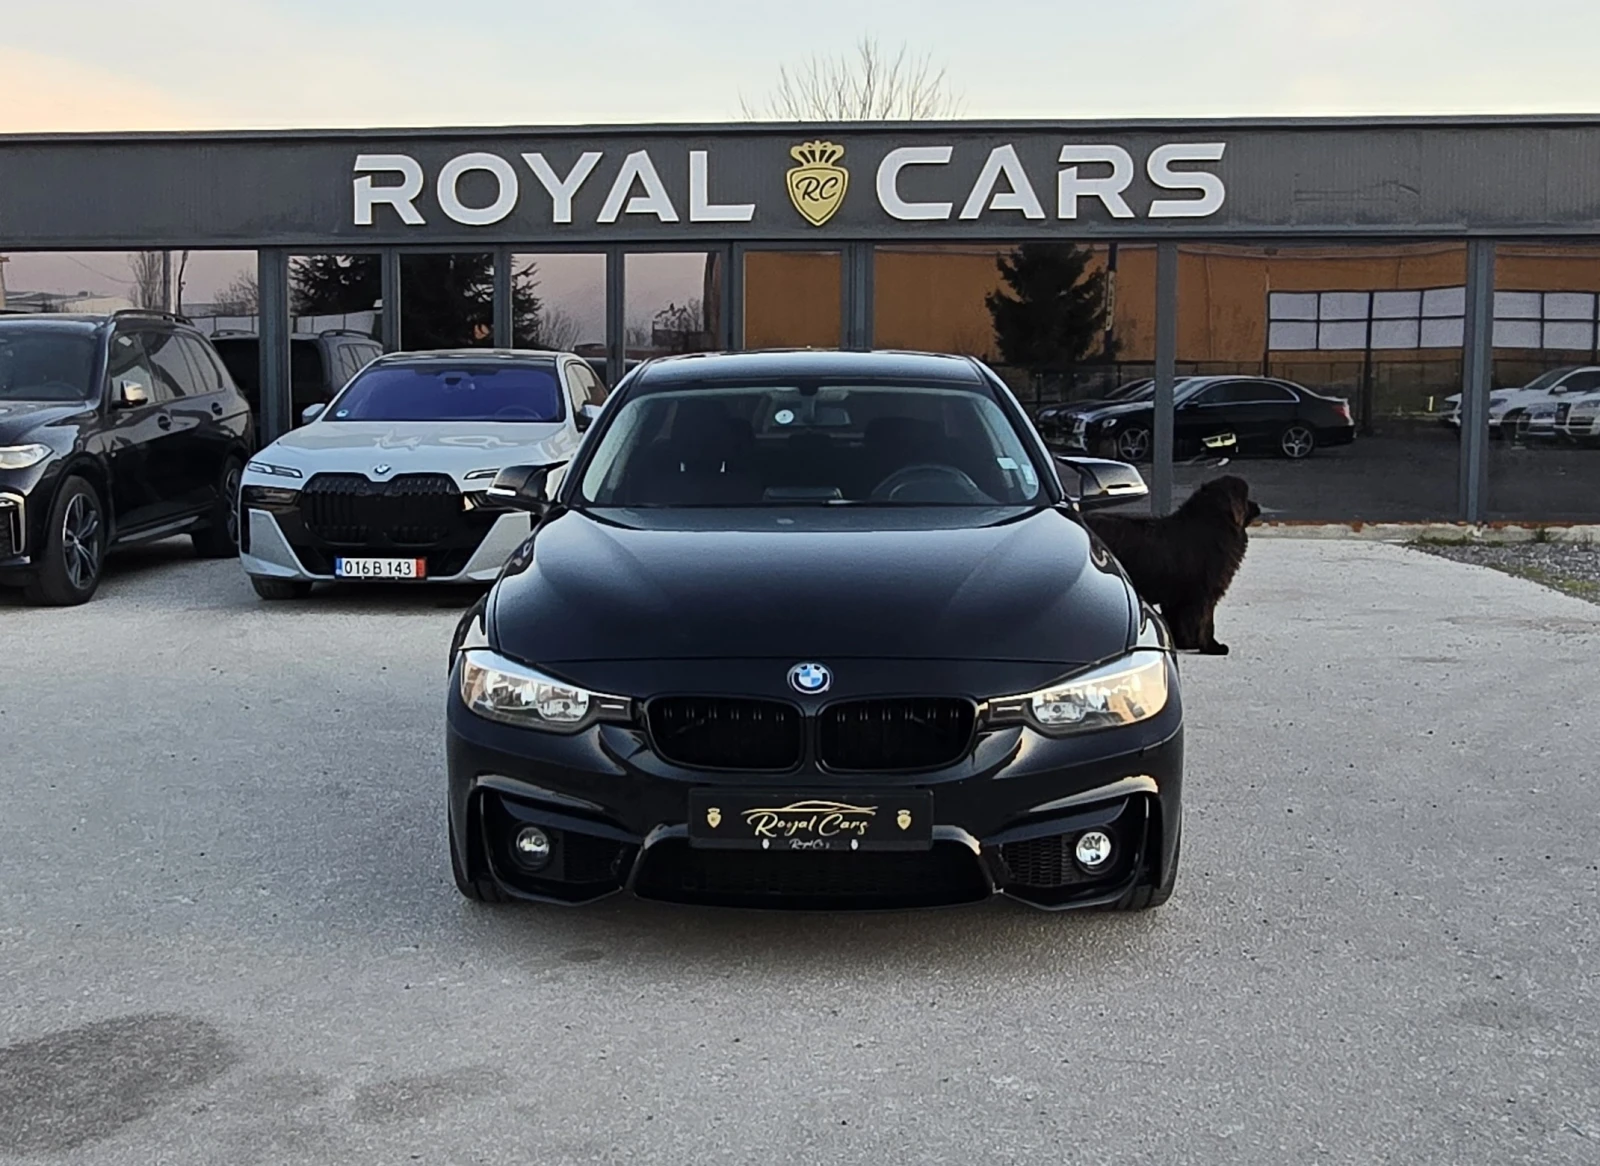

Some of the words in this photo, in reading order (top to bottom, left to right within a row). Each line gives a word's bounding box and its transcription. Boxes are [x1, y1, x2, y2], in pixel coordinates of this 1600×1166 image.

[353, 149, 756, 226] ROYAL
[876, 142, 1226, 220] CARS
[795, 176, 839, 202] RC
[746, 812, 817, 837] Royal
[818, 813, 868, 836] Cars
